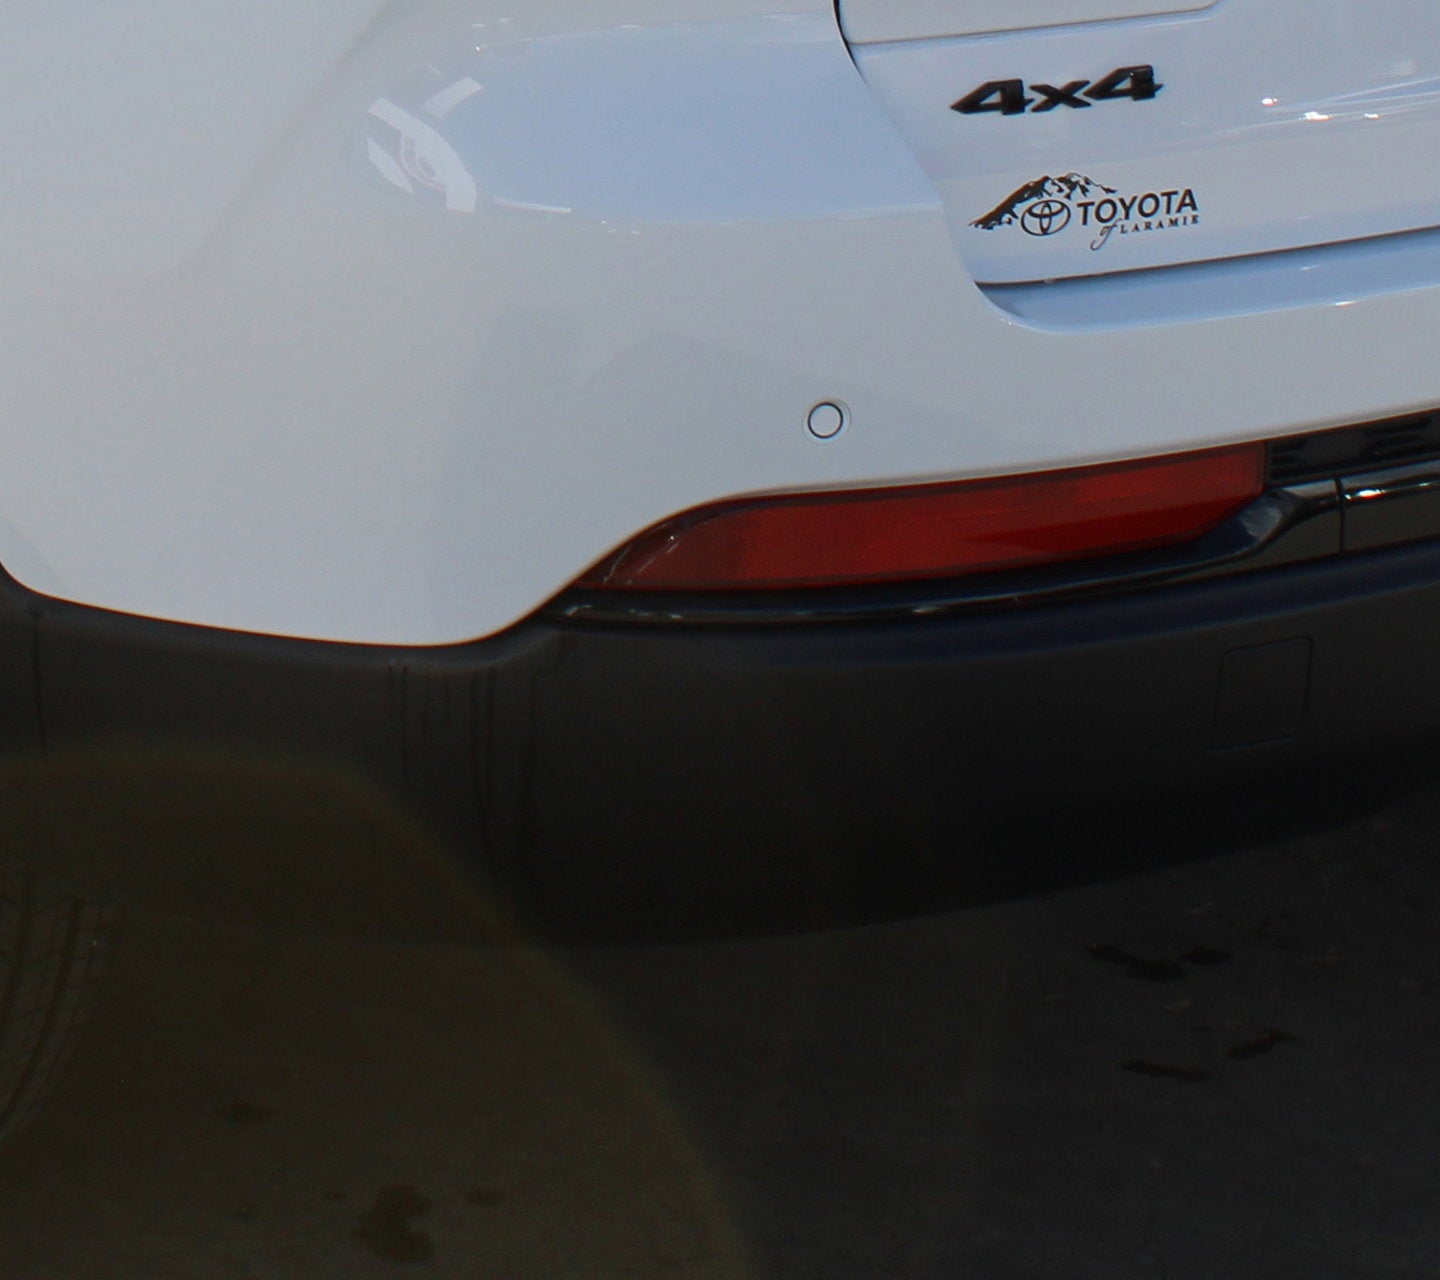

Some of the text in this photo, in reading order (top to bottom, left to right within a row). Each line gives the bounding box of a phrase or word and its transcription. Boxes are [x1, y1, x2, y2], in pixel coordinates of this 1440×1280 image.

[950, 63, 1165, 116] 4x4
[1076, 188, 1199, 227] TOYOTA
[1119, 214, 1200, 235] LARAMIE
